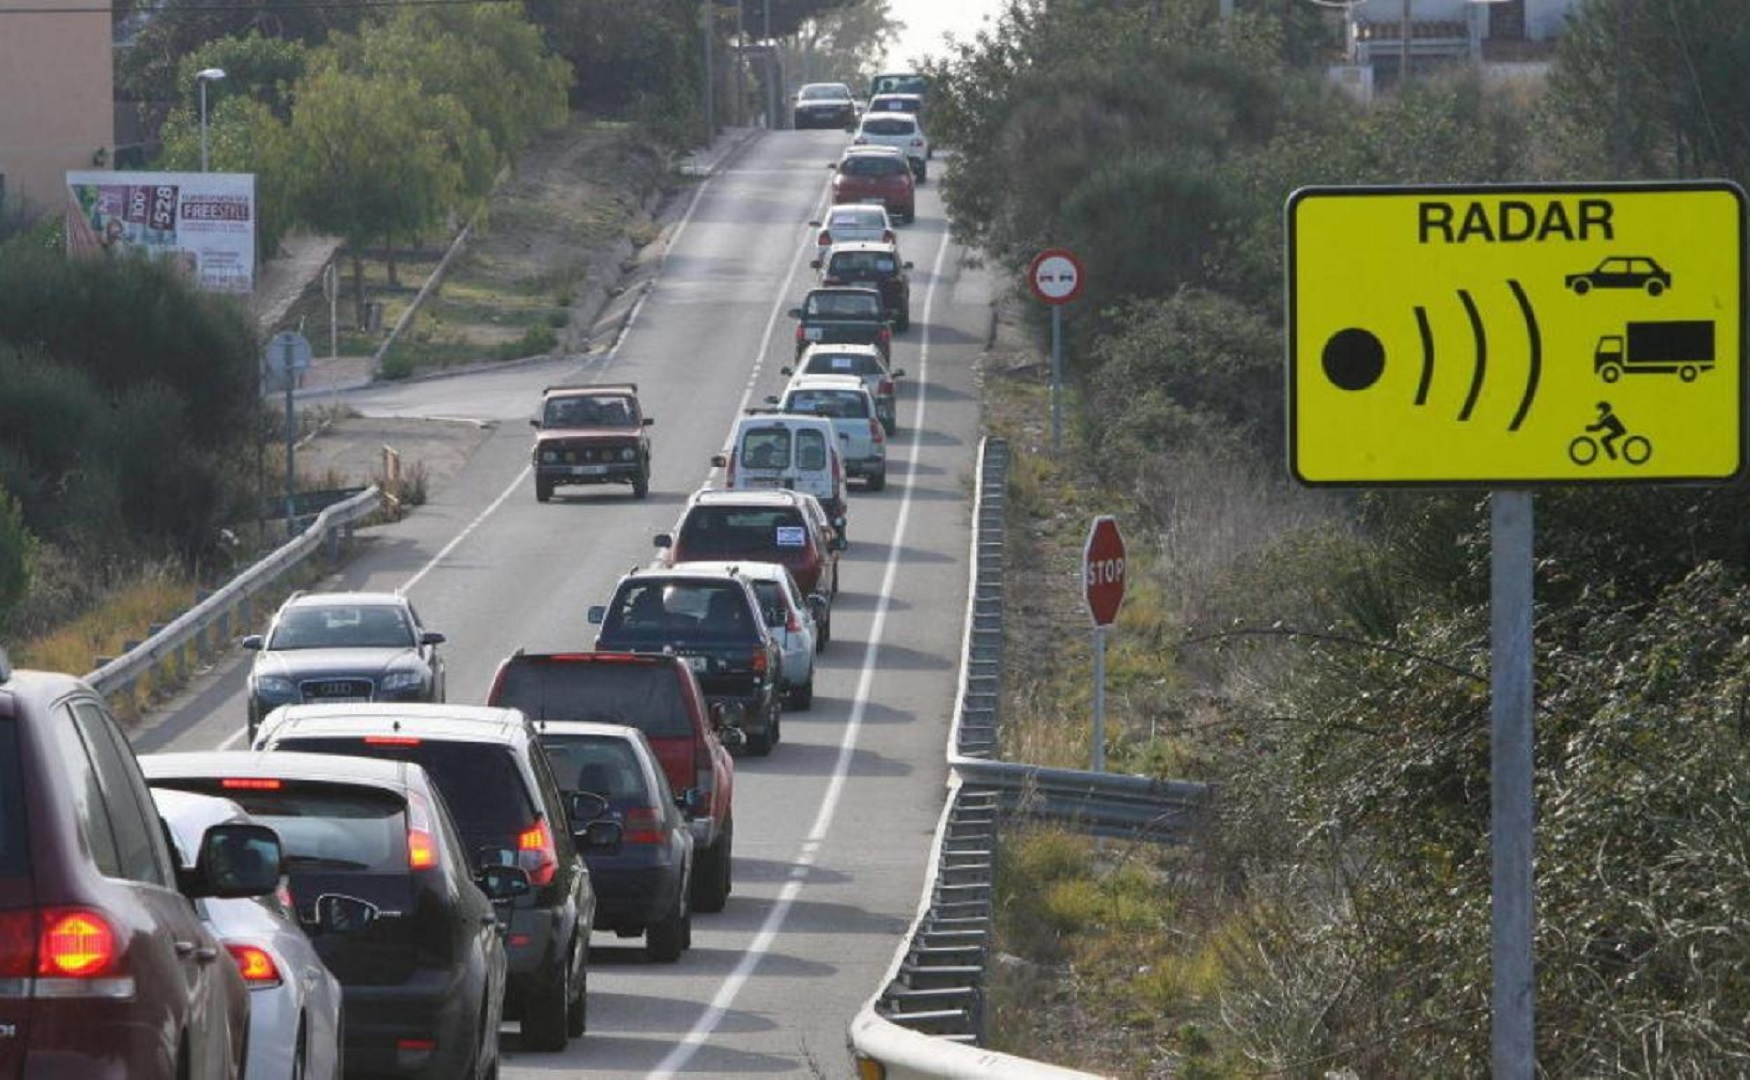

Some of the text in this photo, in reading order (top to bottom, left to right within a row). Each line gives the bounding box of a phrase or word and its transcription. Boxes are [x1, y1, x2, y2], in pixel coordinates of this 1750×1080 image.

[156, 186, 174, 223] 528
[1419, 199, 1615, 244] RADAR
[1088, 558, 1125, 585] STOP
